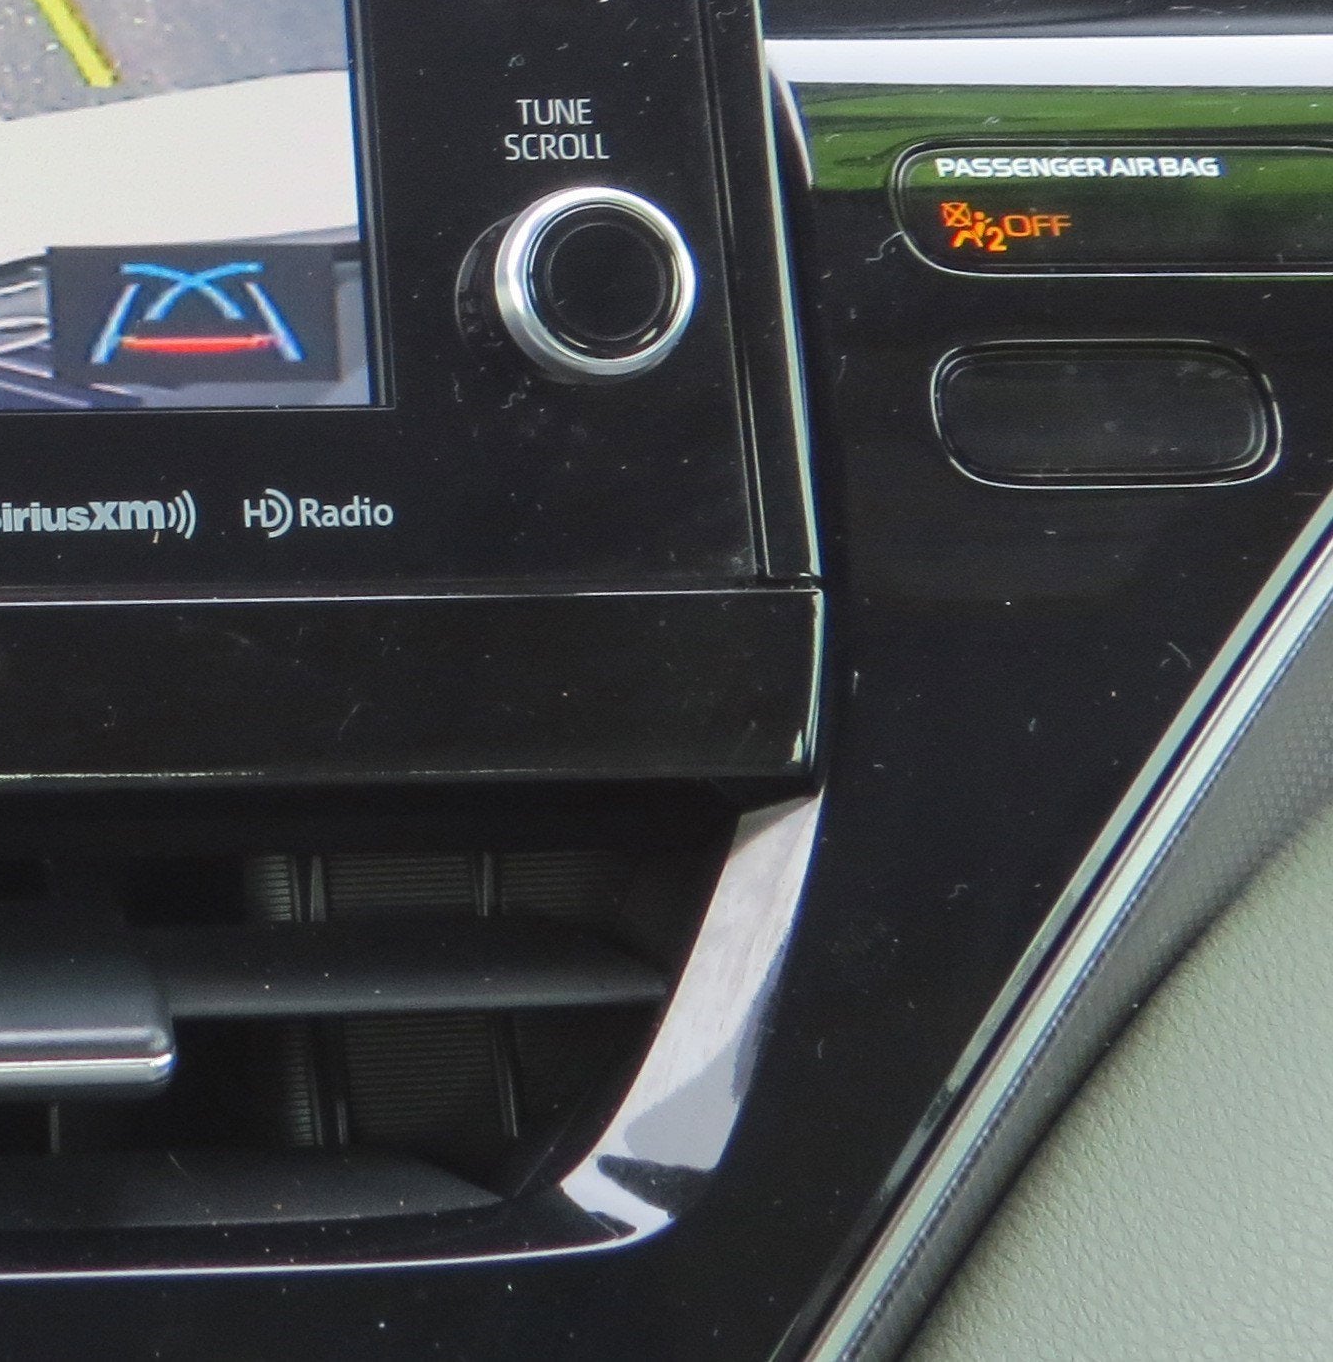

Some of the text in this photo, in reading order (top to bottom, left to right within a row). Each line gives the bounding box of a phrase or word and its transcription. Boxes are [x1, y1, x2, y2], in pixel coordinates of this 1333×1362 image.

[516, 99, 593, 125] TUNE
[504, 134, 610, 161] SCROLL
[935, 157, 1221, 178] PASSENGER AIR BAG
[1003, 214, 1072, 238] OFF
[243, 491, 394, 534] HD Radio
